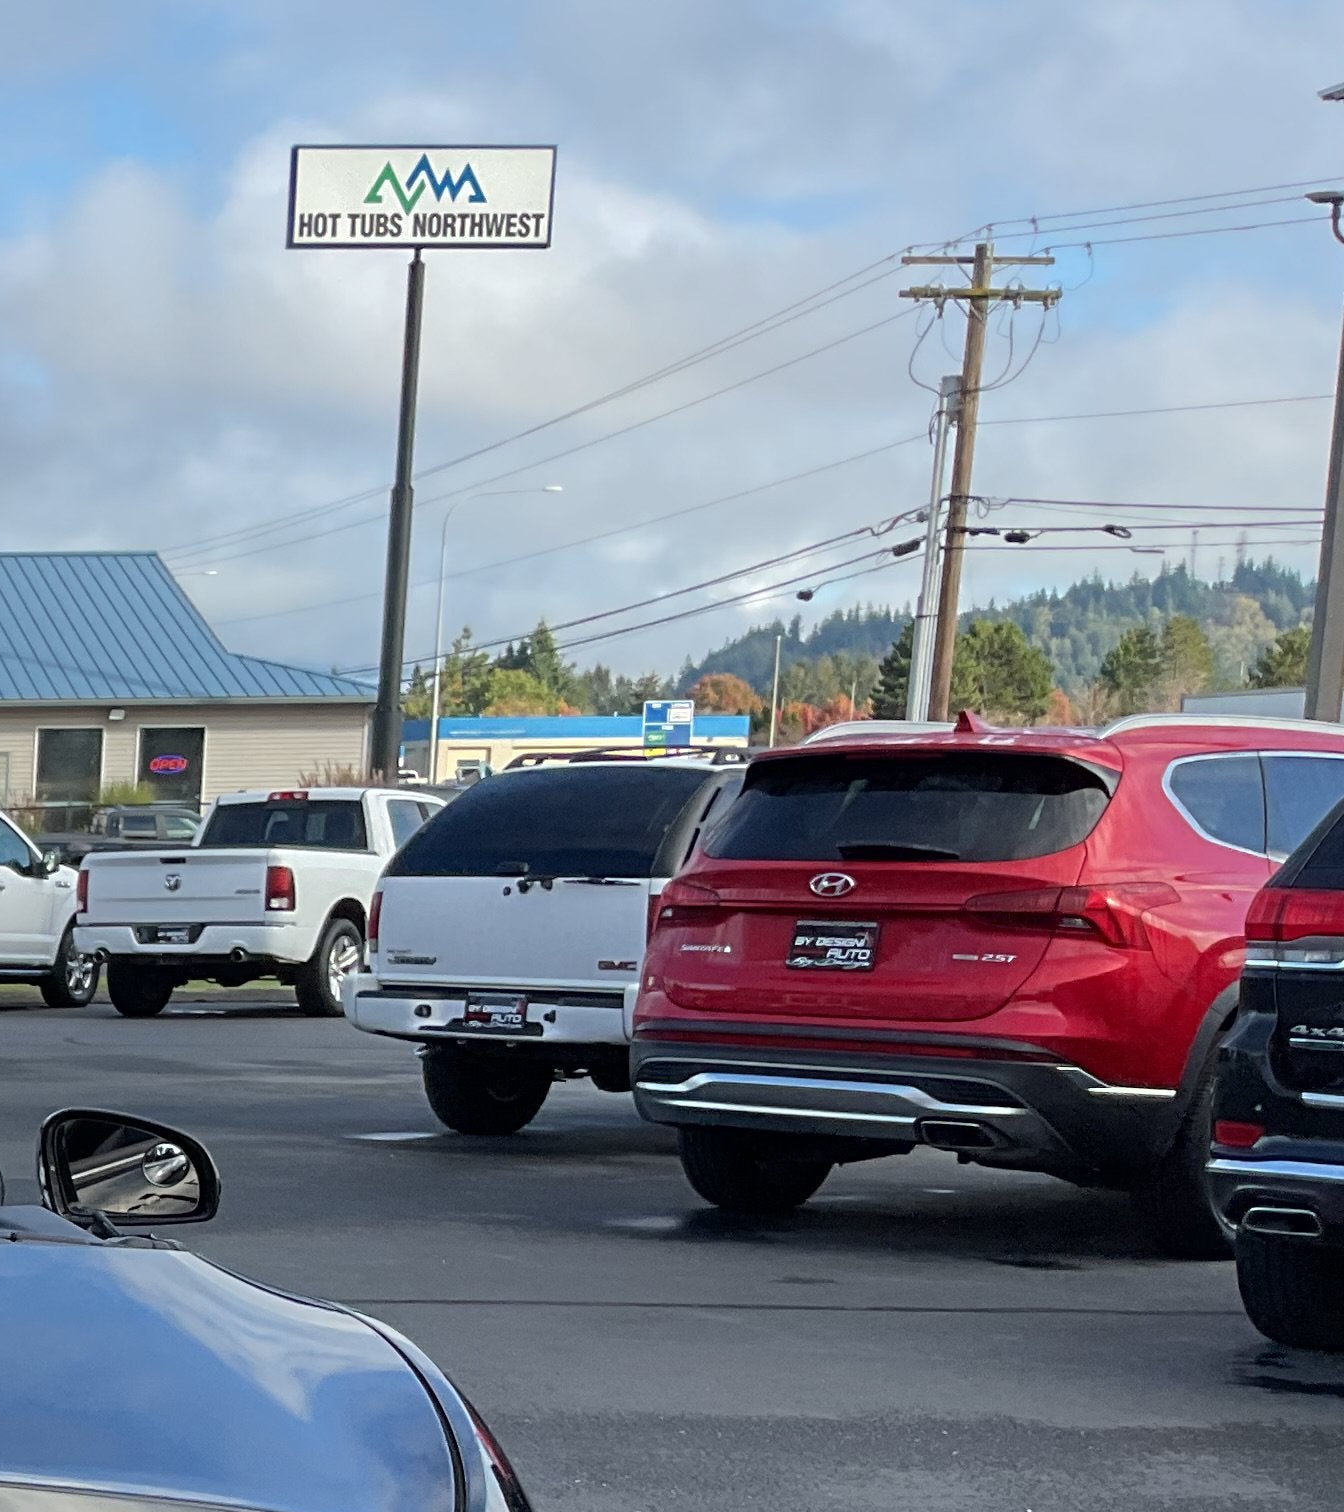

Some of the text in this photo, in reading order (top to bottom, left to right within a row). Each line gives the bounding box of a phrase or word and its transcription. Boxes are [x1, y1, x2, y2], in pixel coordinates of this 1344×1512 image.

[299, 213, 545, 238] HOT TUBS NORTHWEST
[149, 757, 188, 772] OPEN
[794, 936, 814, 946] BY
[826, 948, 871, 960] AUTO
[598, 960, 638, 971] GMC
[490, 1013, 523, 1024] AUTO
